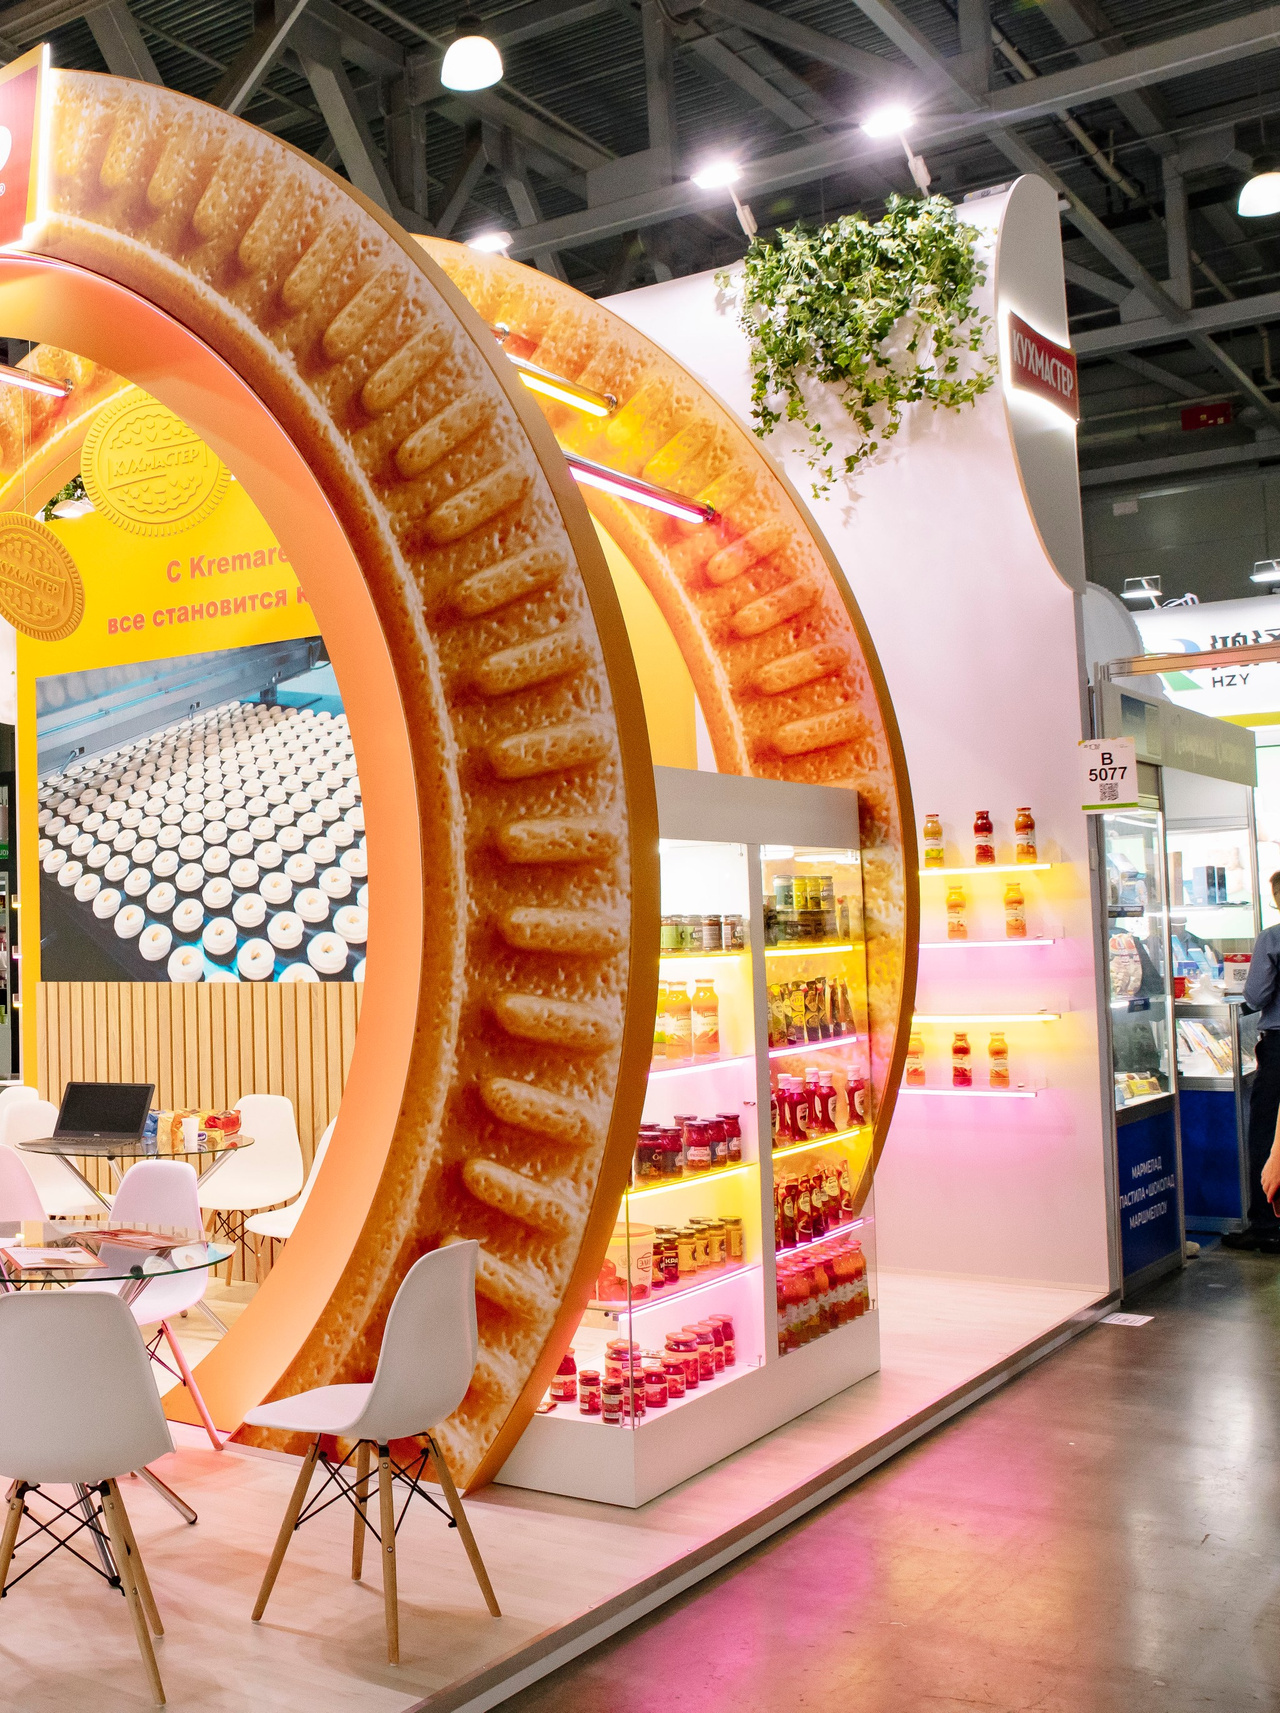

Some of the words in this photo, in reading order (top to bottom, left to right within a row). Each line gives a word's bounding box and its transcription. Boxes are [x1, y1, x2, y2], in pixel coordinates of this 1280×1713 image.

[1011, 329, 1074, 398] КУХМАСТЕР
[112, 447, 201, 477] КУХМАСТЕР
[107, 611, 144, 635] все
[152, 590, 287, 627] становится
[1212, 673, 1250, 689] HZY
[1100, 752, 1114, 766] B
[1088, 766, 1128, 782] 5077
[1131, 1156, 1162, 1179] МАРМЕЛАД
